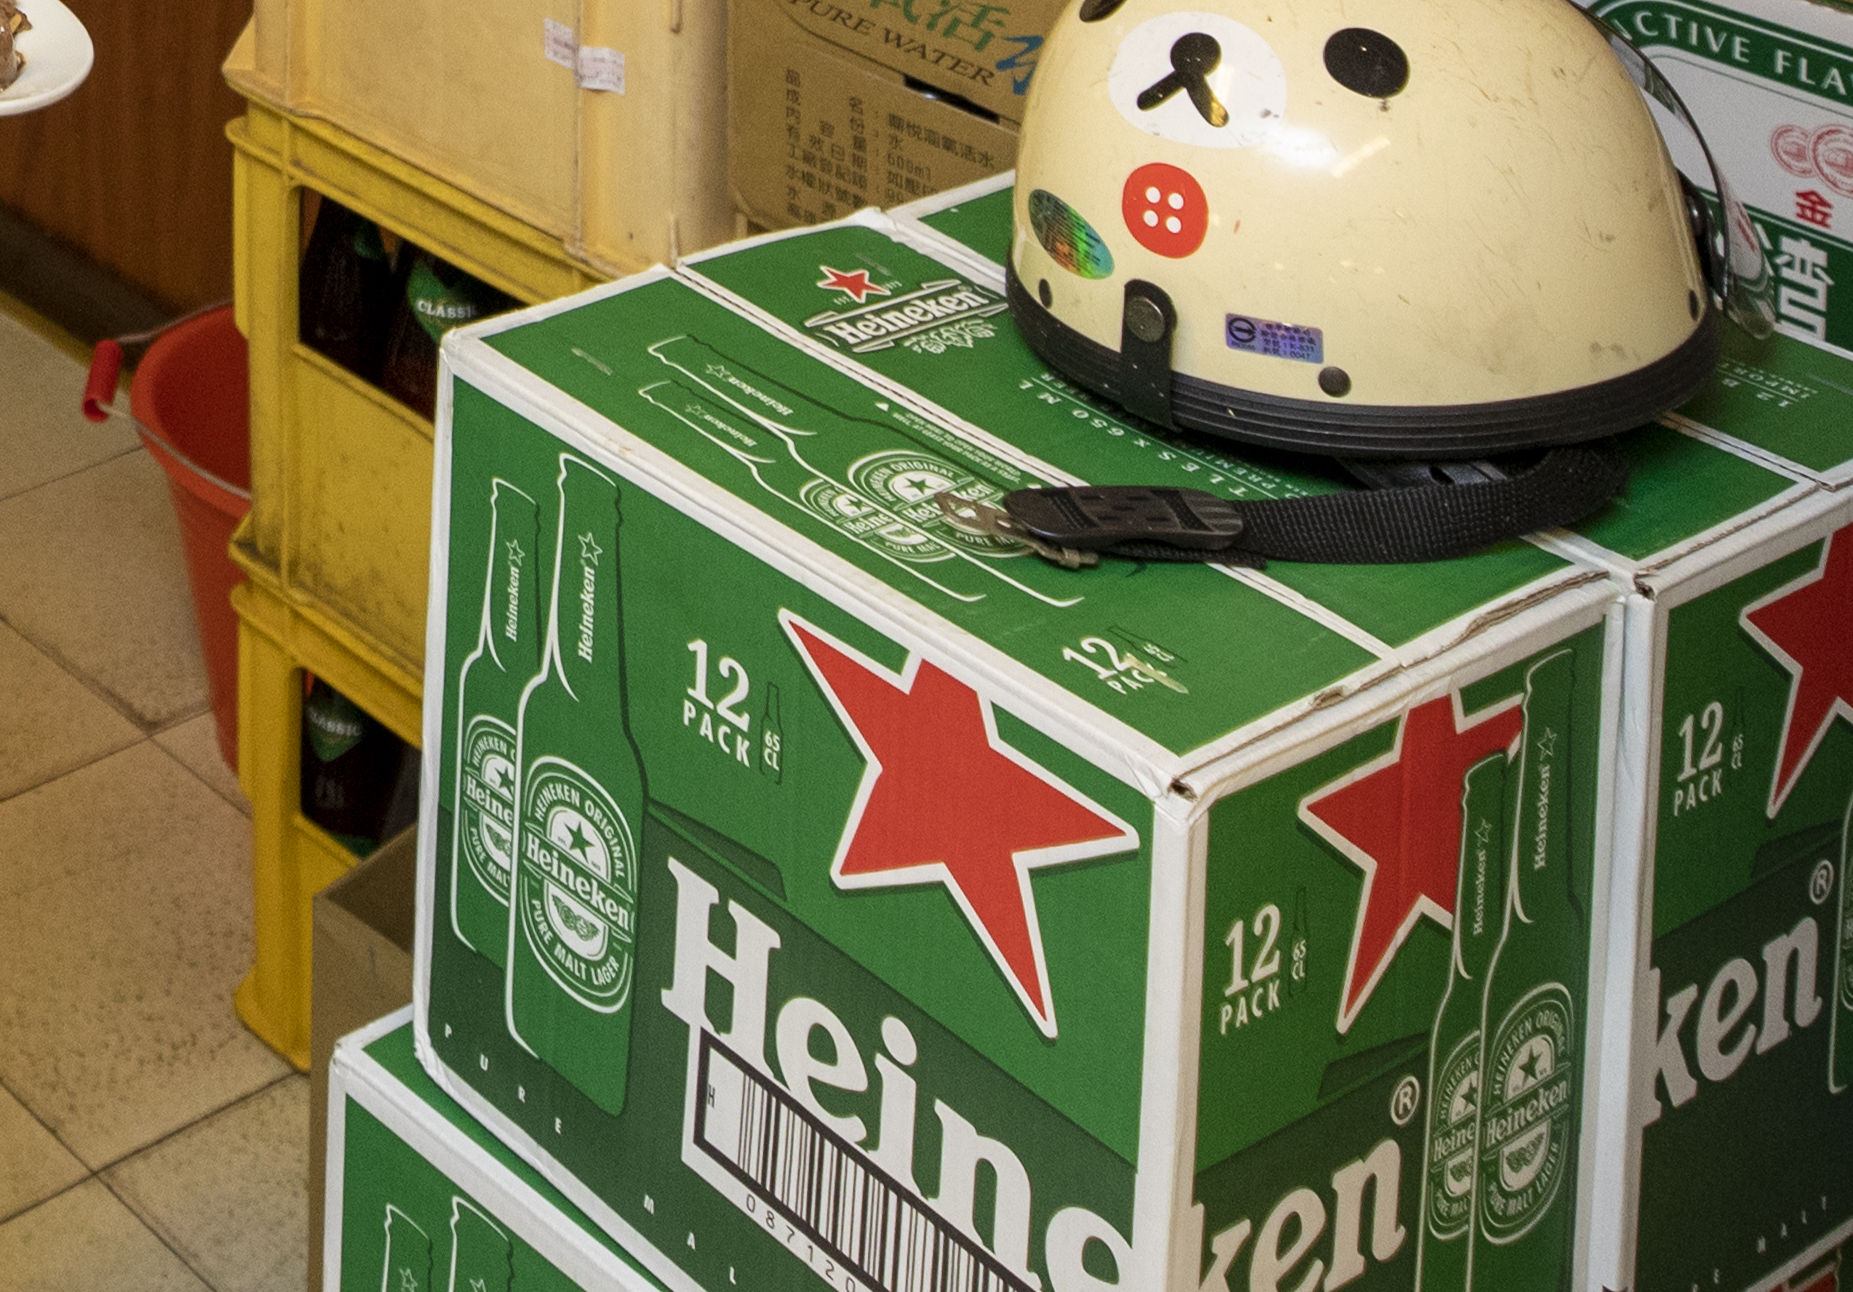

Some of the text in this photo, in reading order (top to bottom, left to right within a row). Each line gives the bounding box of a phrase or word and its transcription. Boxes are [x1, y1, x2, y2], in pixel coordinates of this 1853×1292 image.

[881, 22, 997, 88] WATER
[1774, 48, 1853, 97] FLA
[823, 289, 991, 346] Heineken
[727, 374, 795, 417] Heineken
[1017, 378, 1063, 407] ML
[701, 411, 759, 448] Heineken
[1071, 407, 1127, 439] 650
[894, 459, 956, 479] ORIGINAL
[901, 482, 994, 523] Heiken
[505, 564, 521, 643] Heineken
[577, 565, 596, 664] Heineken
[1061, 636, 1132, 681] 12
[686, 637, 751, 734] 12
[471, 735, 509, 767] HEINEKEN
[682, 698, 751, 769] PACK
[763, 730, 782, 753] 65
[1675, 700, 1724, 784] 12
[1731, 732, 1744, 754] 65
[763, 749, 781, 773] CL
[1730, 749, 1744, 771] CL
[1673, 766, 1724, 818] PACK
[534, 781, 627, 880] HEINEKEN ORIGINAL
[1533, 763, 1551, 871] Heineken
[470, 826, 487, 866] PURE
[526, 832, 631, 933] Heineken
[1473, 848, 1487, 938] Heineken
[531, 898, 621, 988] PURE MALT LAGER
[1224, 903, 1282, 998] 12
[1292, 938, 1308, 962] 65
[1291, 957, 1307, 983] CL
[1219, 978, 1281, 1036] PACK
[1492, 1016, 1534, 1097] HEINEKEN
[707, 1084, 716, 1110] H
[1484, 1079, 1569, 1149] Heineken
[1505, 1186, 1536, 1218] MALT
